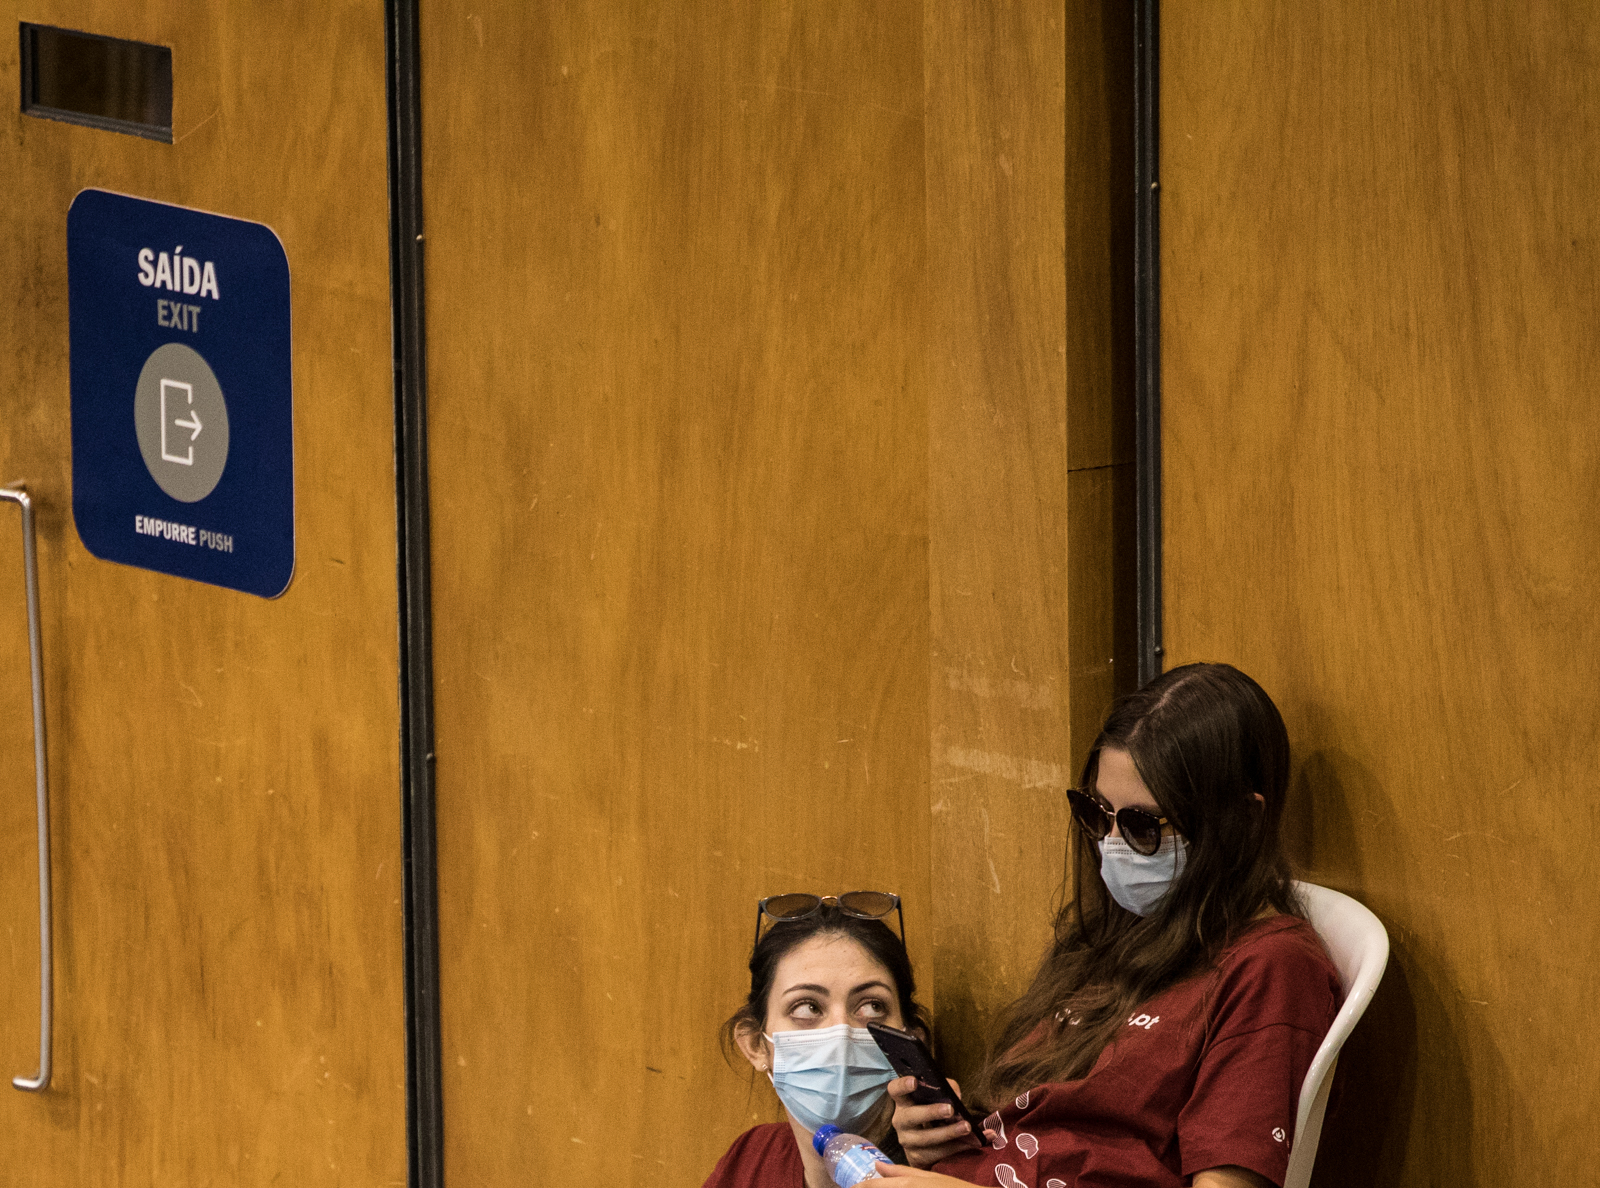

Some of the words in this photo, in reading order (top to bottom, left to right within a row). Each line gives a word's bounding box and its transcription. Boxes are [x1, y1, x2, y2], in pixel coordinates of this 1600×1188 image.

[137, 245, 220, 300] SAÍDA
[157, 299, 201, 333] EXIT
[135, 515, 197, 546] EMPURRE
[199, 529, 233, 554] PUSH
